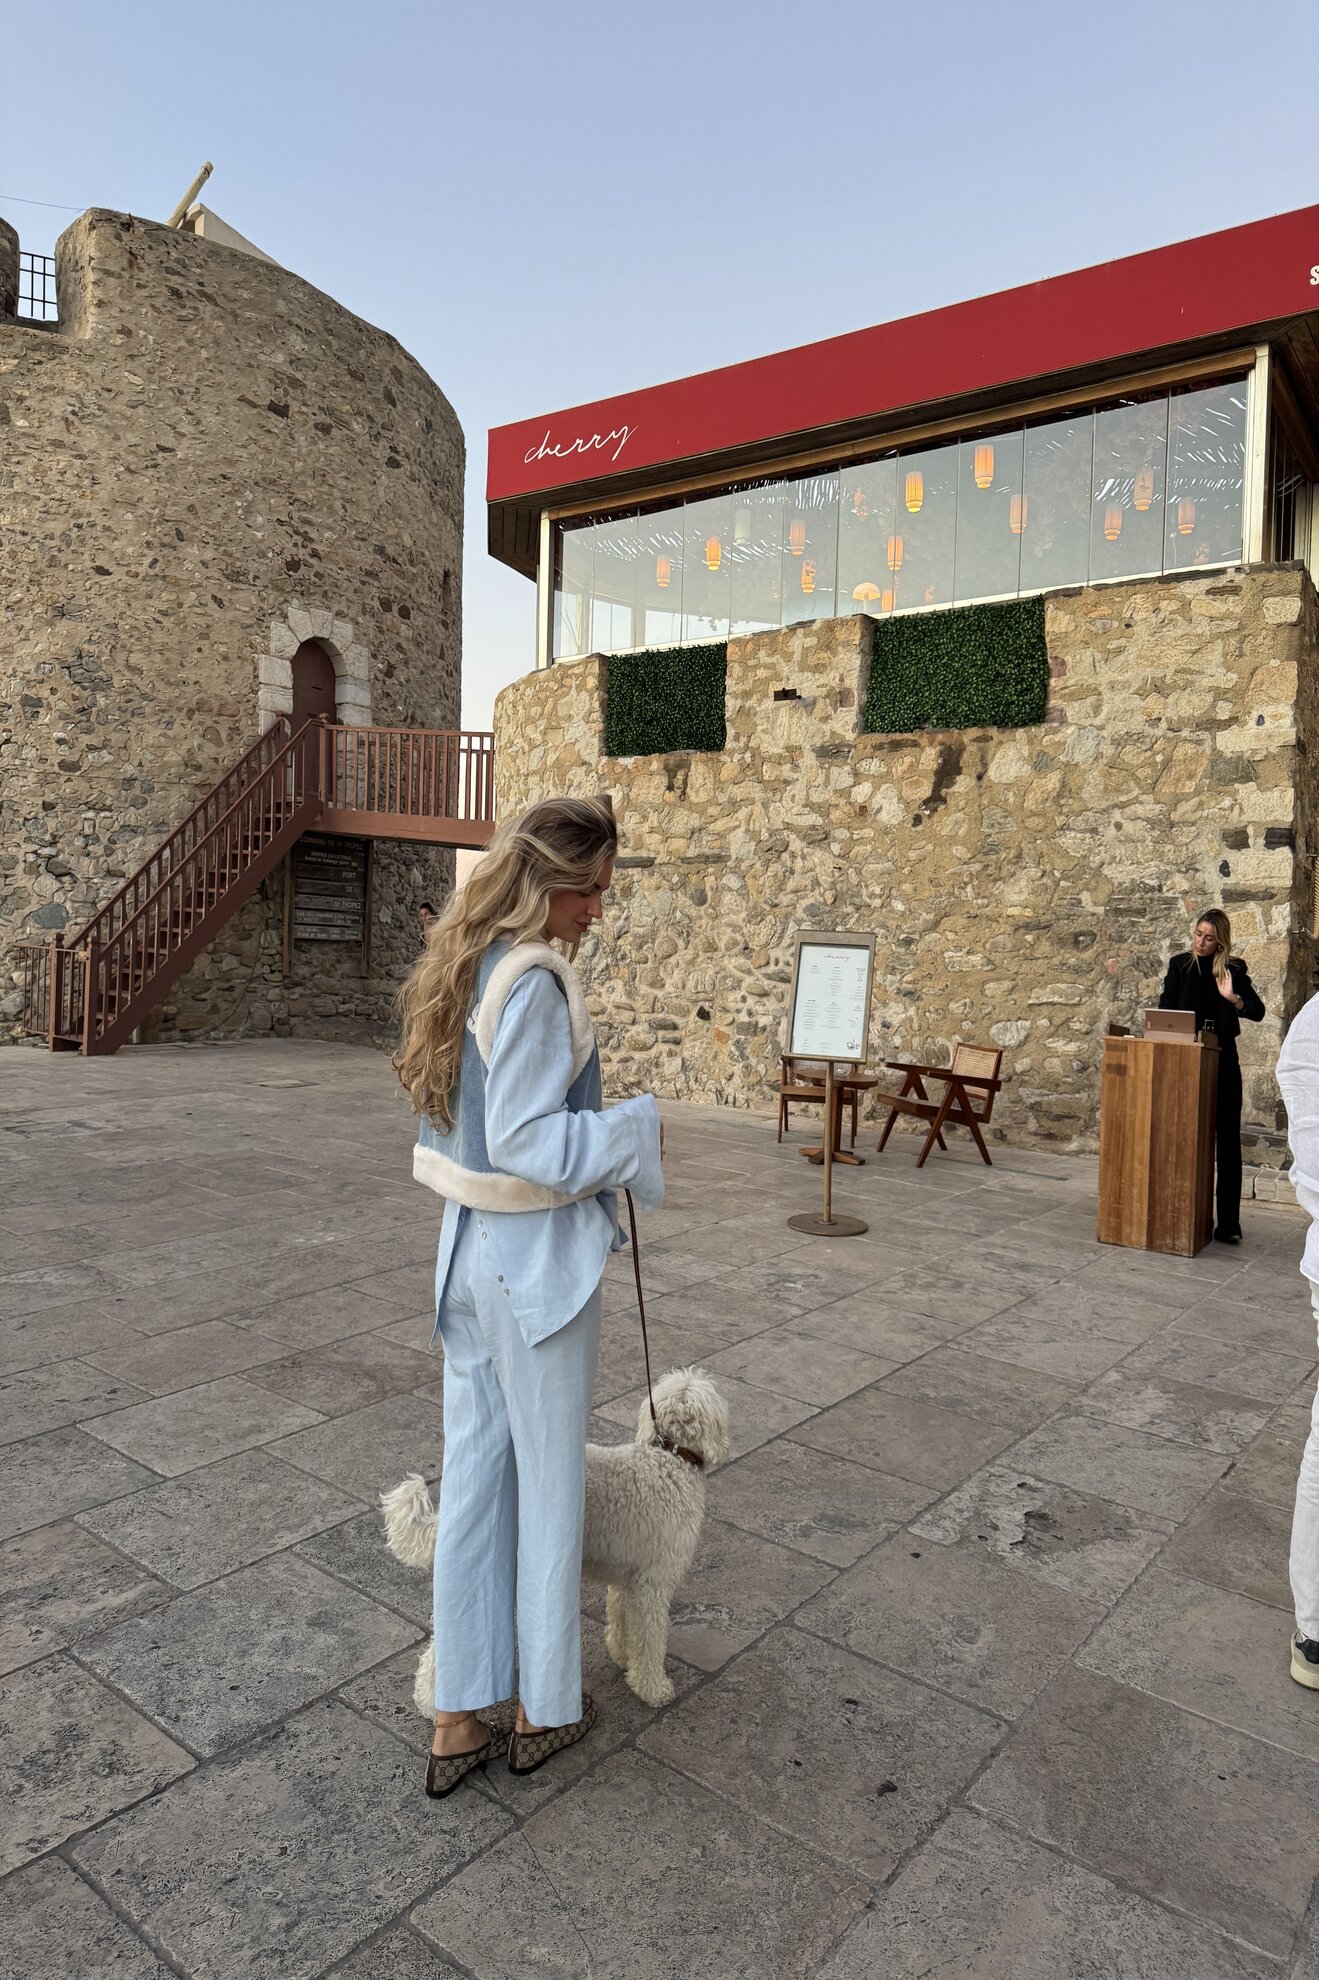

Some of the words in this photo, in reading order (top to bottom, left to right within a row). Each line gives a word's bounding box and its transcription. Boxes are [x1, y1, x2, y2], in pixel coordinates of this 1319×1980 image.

[524, 425, 638, 464] cherry
[342, 871, 356, 879] PORT
[342, 901, 362, 909] TROPEZ
